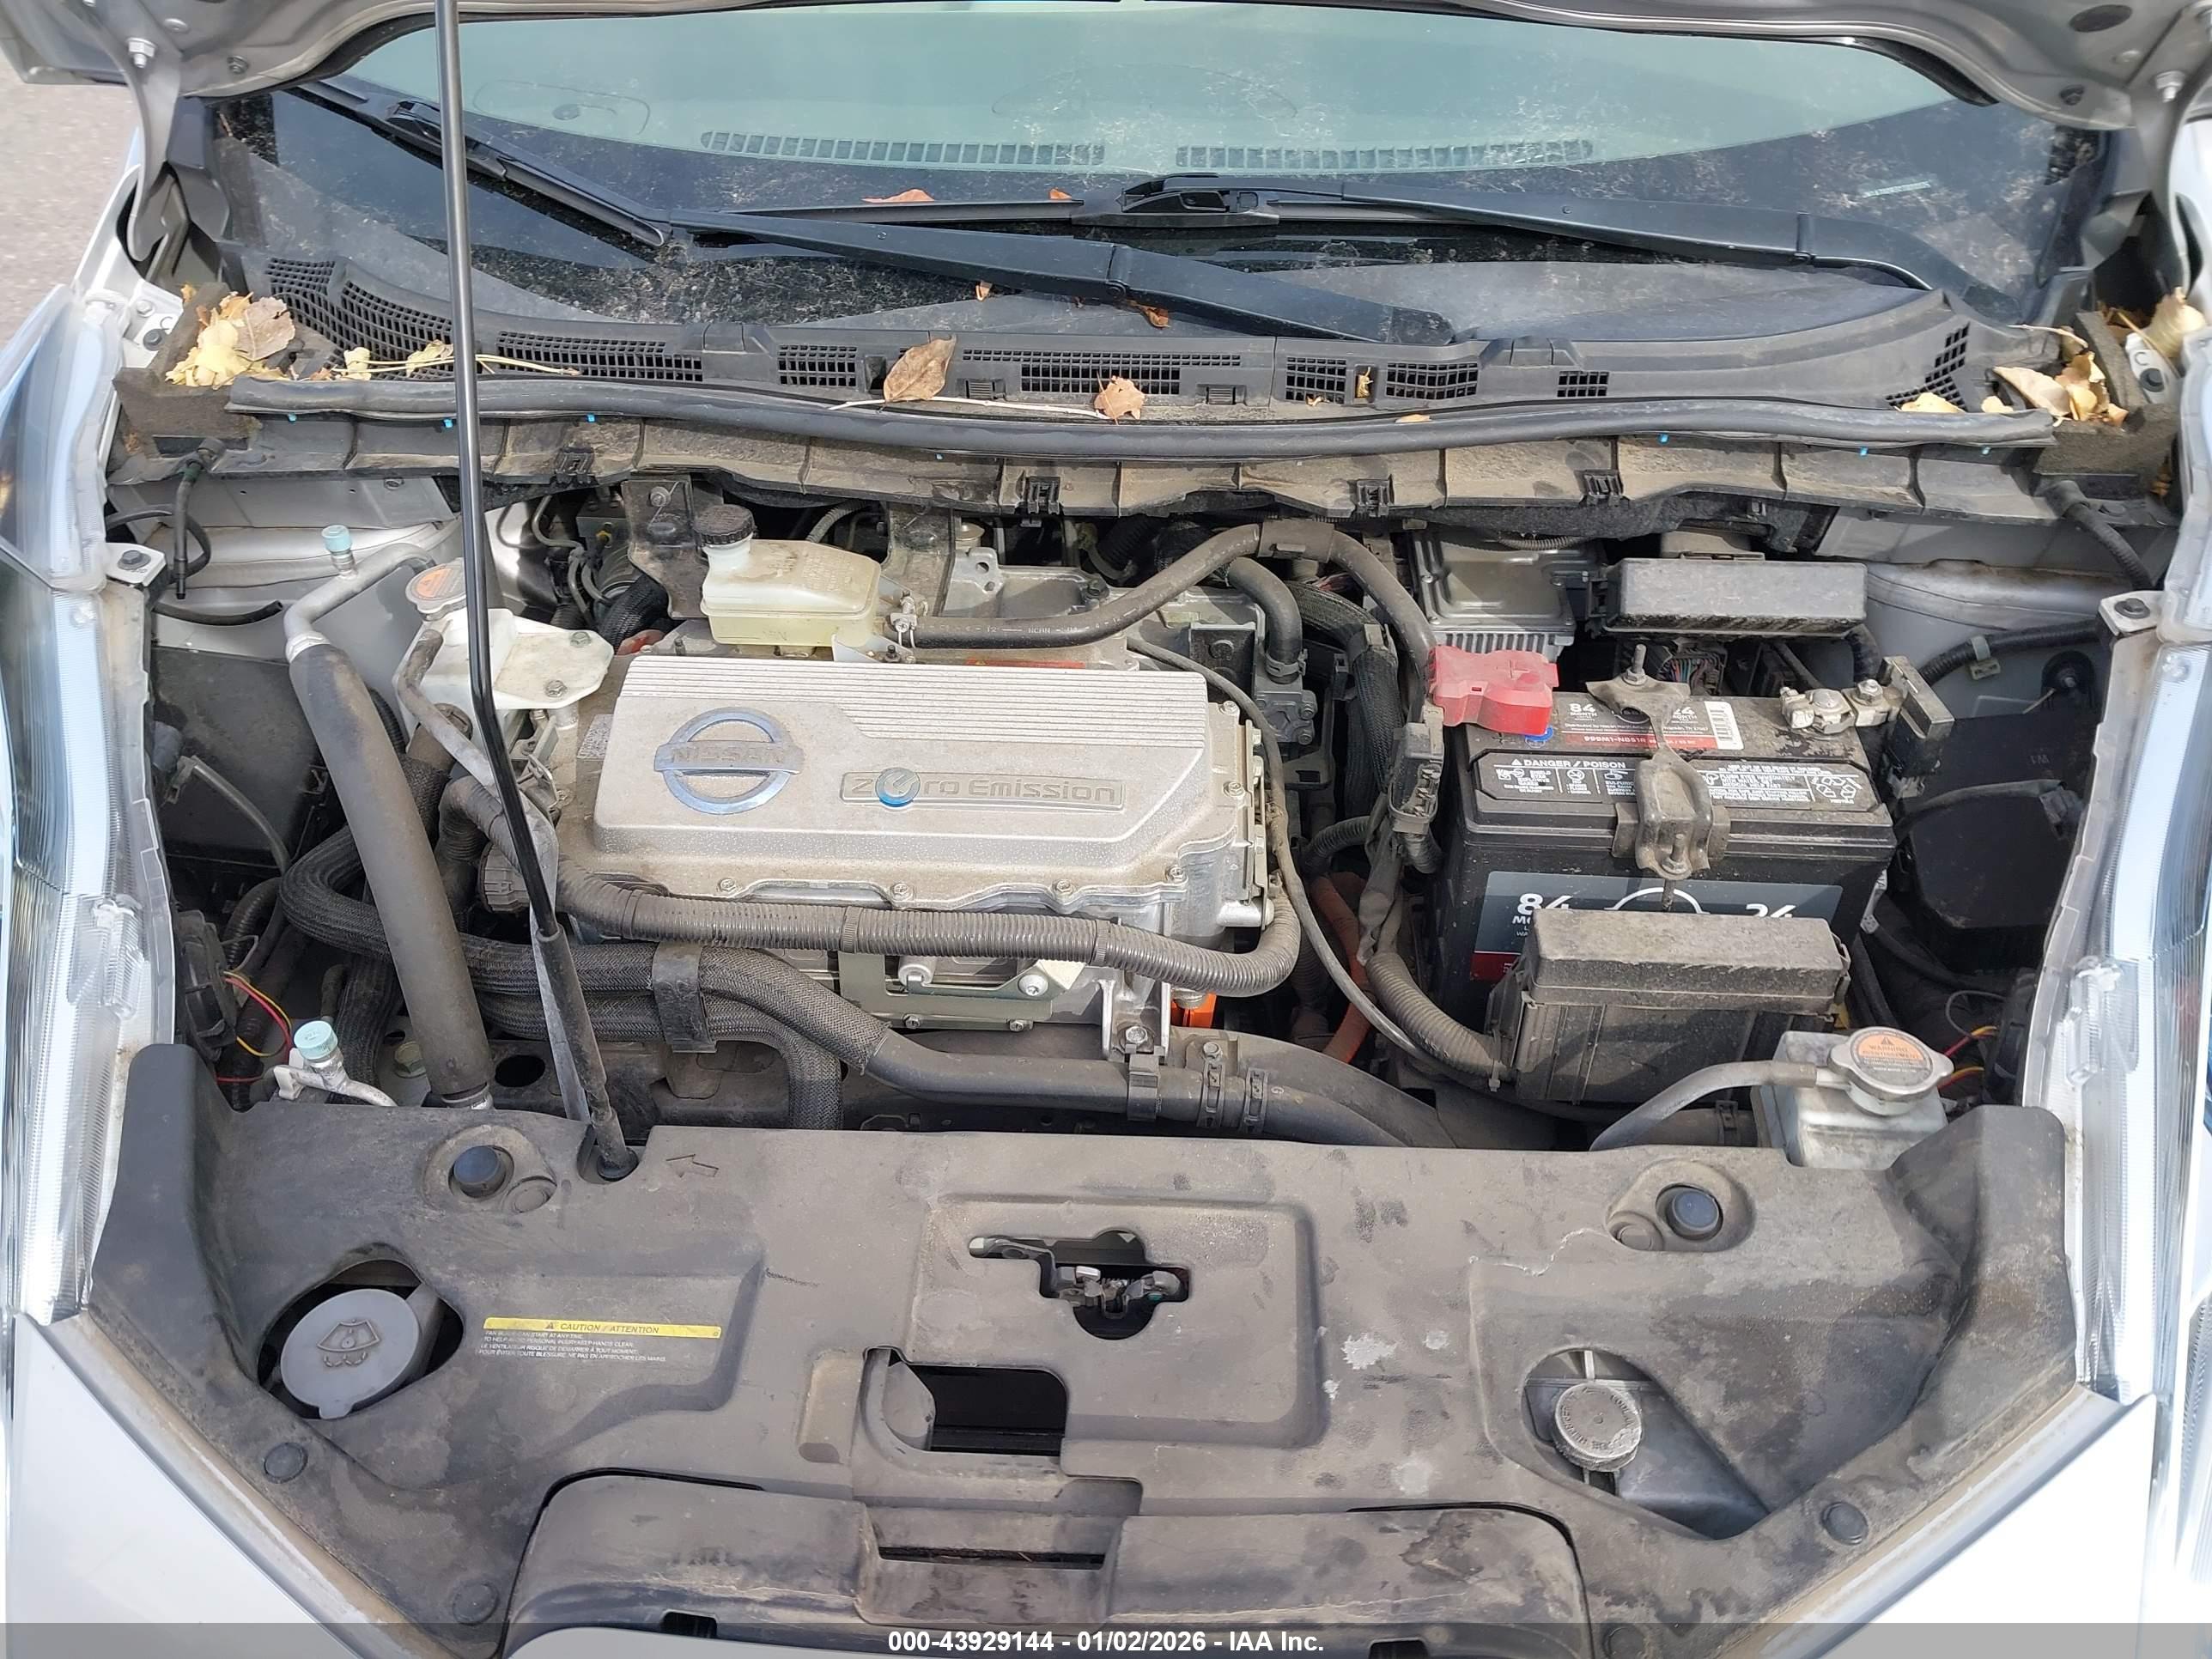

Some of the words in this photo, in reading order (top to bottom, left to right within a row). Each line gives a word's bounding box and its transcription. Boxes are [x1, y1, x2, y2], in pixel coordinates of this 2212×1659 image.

[1570, 702, 1595, 713] 84
[673, 746, 785, 763] NISSAN
[1523, 759, 1570, 768] DANGER
[1517, 893, 1573, 915] 84
[561, 1323, 601, 1332] CAUTION
[611, 1325, 659, 1334] ATTENTION
